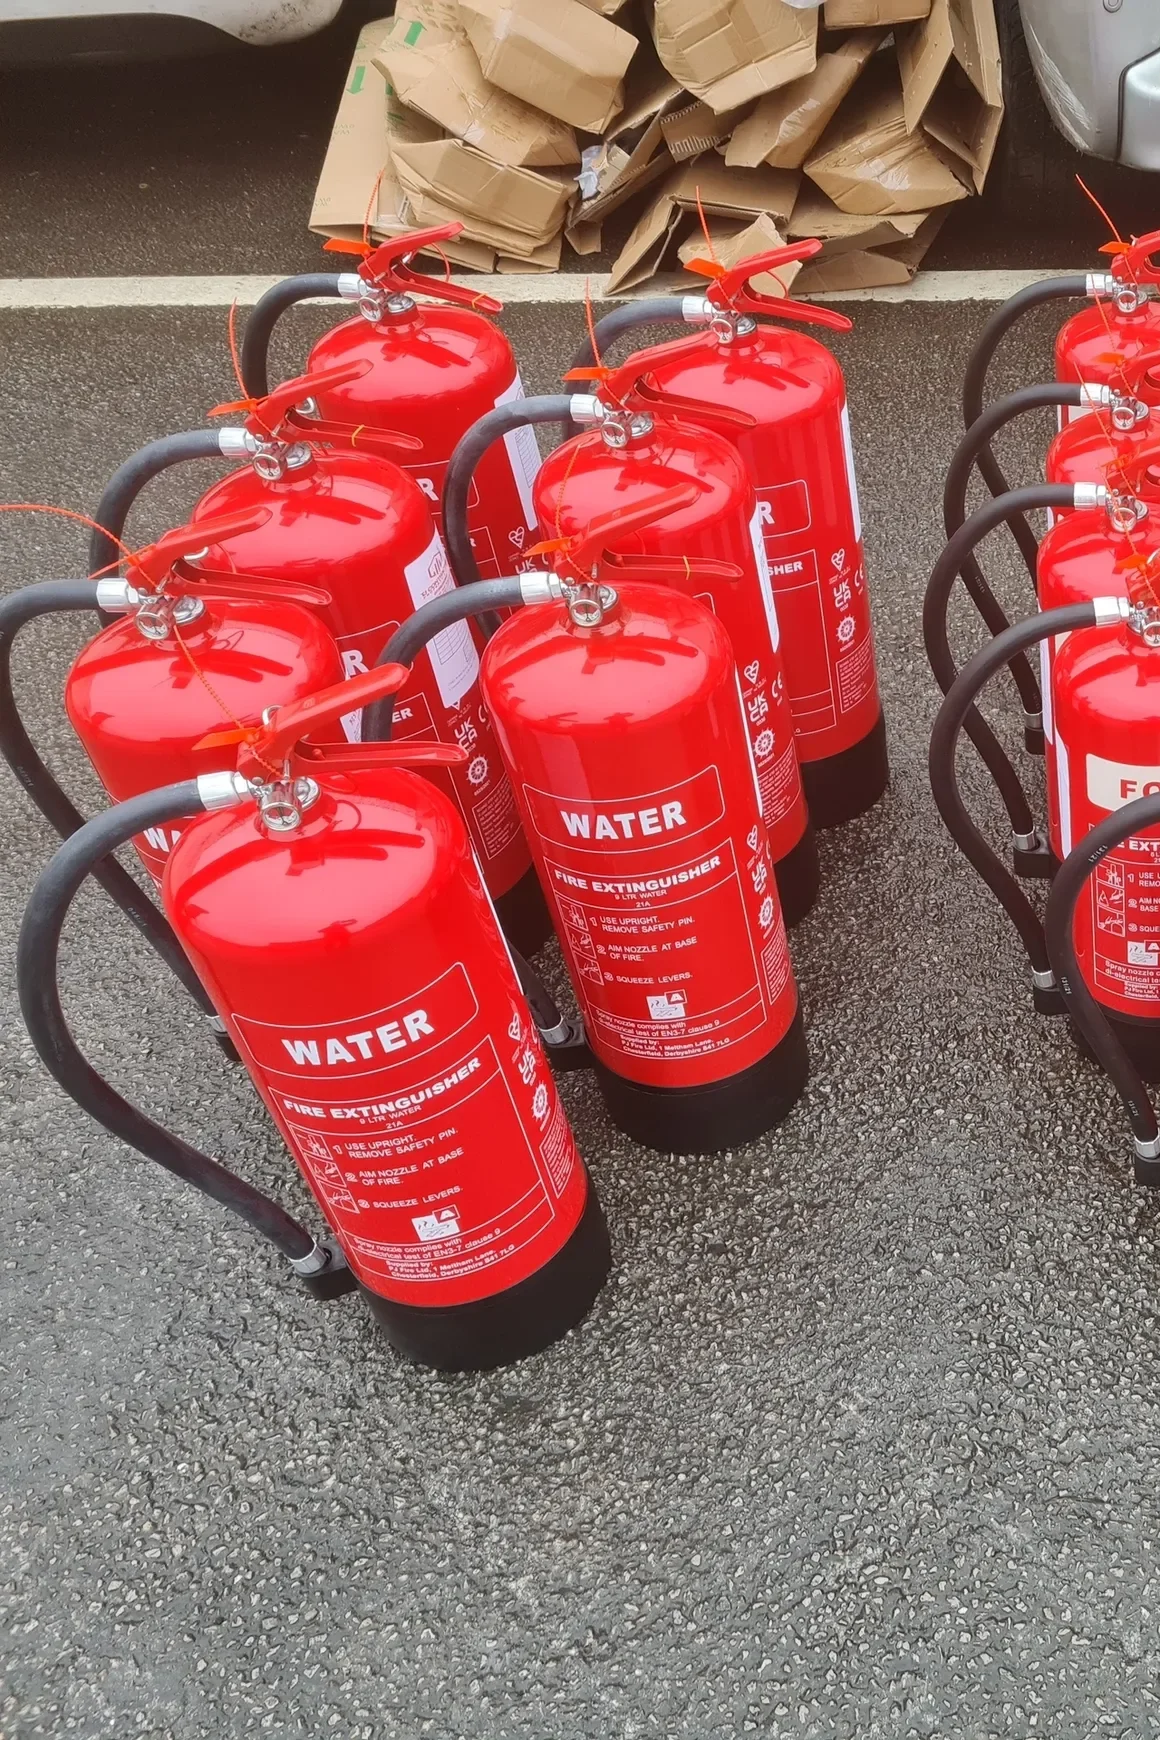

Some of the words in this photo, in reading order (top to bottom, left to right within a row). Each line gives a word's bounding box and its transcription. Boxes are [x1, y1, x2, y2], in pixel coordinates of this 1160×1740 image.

[560, 801, 687, 840] WATER
[554, 870, 588, 889] FIRE
[592, 855, 721, 893] EXTINGUISHER
[639, 889, 667, 898] WATER
[590, 917, 597, 926] 1
[600, 916, 617, 924] USE
[618, 916, 660, 924] UPRIGHT.
[602, 924, 638, 933] REMOVE
[642, 921, 674, 933] SAFETY
[678, 916, 695, 926] PIN.
[596, 944, 606, 955] 2
[608, 944, 622, 952] AIM
[624, 945, 657, 953] NOZZLE
[662, 942, 671, 951] AT
[675, 936, 697, 948] BASE
[1105, 960, 1127, 973] Spray
[616, 975, 654, 984] SQUEEZE
[658, 972, 693, 983] LEVERS.
[281, 1009, 435, 1066] WATER
[283, 1099, 326, 1118] FIRE
[331, 1057, 481, 1119] EXTINGUISHER
[368, 1115, 385, 1124] LTR
[389, 1105, 422, 1120] WATER
[386, 1121, 403, 1130] 21A
[333, 1145, 343, 1154] 1
[345, 1142, 366, 1150] USE
[368, 1134, 416, 1149] UPRIGHT.
[349, 1150, 392, 1159] REMOVE
[396, 1137, 435, 1153] SAFETY
[438, 1127, 458, 1140] PIN.
[359, 1170, 376, 1178] AIM
[378, 1165, 418, 1177] NOZZLE
[423, 1160, 435, 1169] AT
[439, 1147, 464, 1164] BASE
[345, 1173, 358, 1182] 2
[362, 1178, 375, 1186] OF
[378, 1177, 404, 1185] FIRE.
[373, 1199, 418, 1208] SQUEEZE
[422, 1186, 463, 1203] LEVERS.
[440, 1209, 455, 1220] A
[405, 1244, 442, 1254] complies
[444, 1237, 462, 1248] with
[420, 1251, 431, 1259] of
[434, 1244, 461, 1258] EN3-7
[465, 1233, 493, 1249] clause
